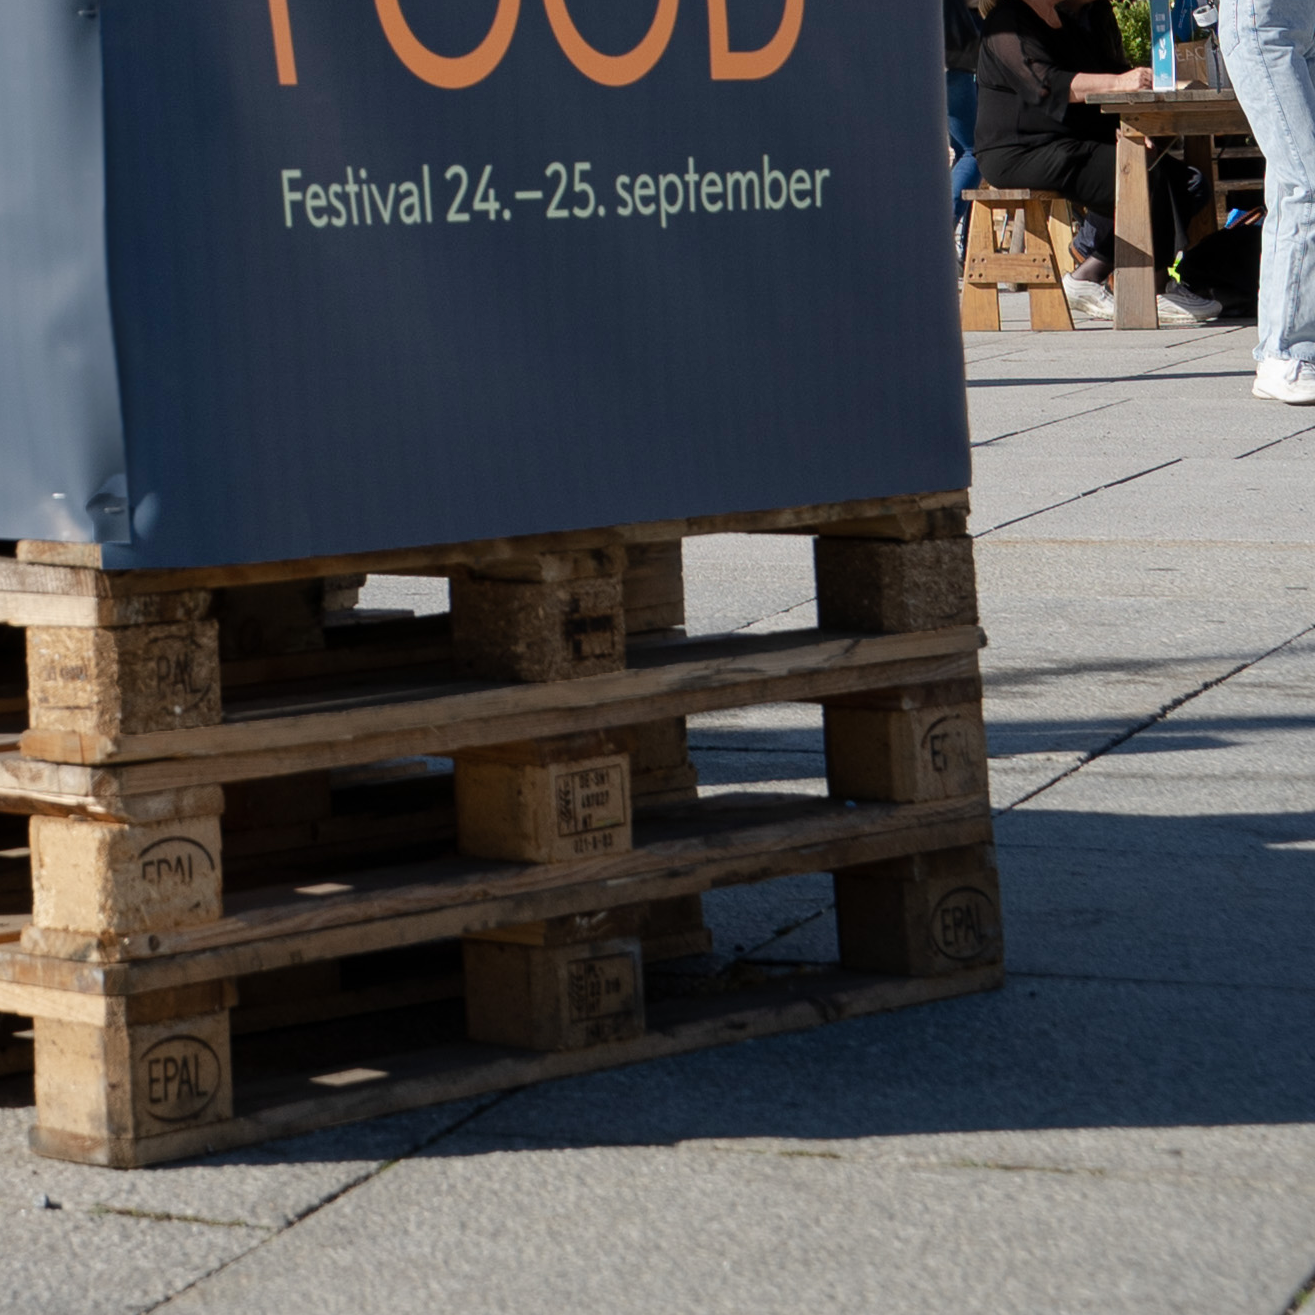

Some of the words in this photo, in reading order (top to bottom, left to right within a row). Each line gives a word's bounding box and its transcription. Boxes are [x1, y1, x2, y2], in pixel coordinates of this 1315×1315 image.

[280, 164, 432, 227] Festival
[617, 154, 830, 228] september
[941, 903, 988, 947] EPAL
[148, 1054, 209, 1104] EPAL
